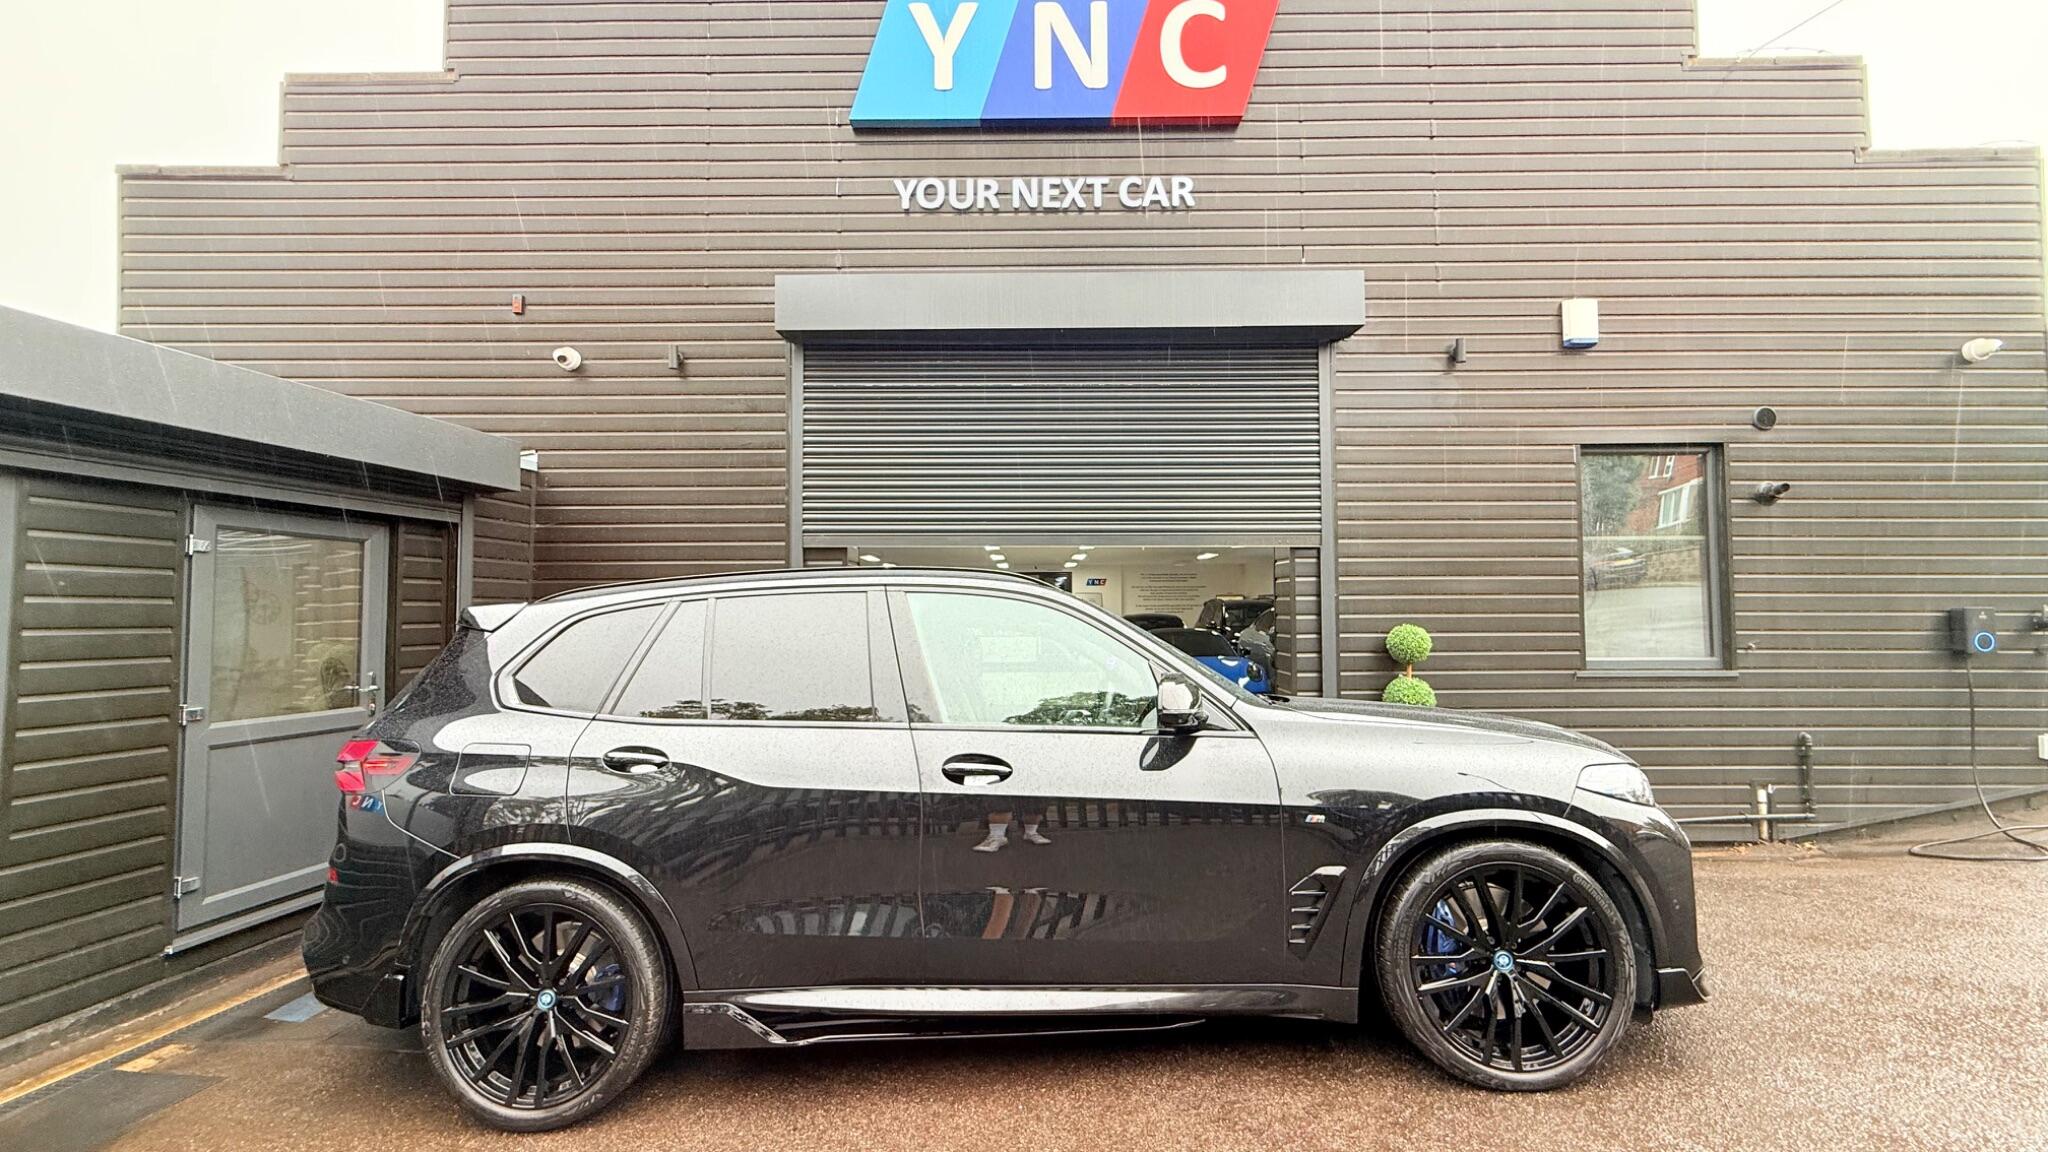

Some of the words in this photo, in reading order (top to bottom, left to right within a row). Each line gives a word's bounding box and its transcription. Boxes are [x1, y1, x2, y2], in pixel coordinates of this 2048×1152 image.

[907, 0, 1227, 91] YNC
[893, 178, 1000, 211] YOUR
[1012, 177, 1109, 209] NEXT
[1118, 175, 1196, 208] CAR
[1087, 578, 1105, 586] YNC
